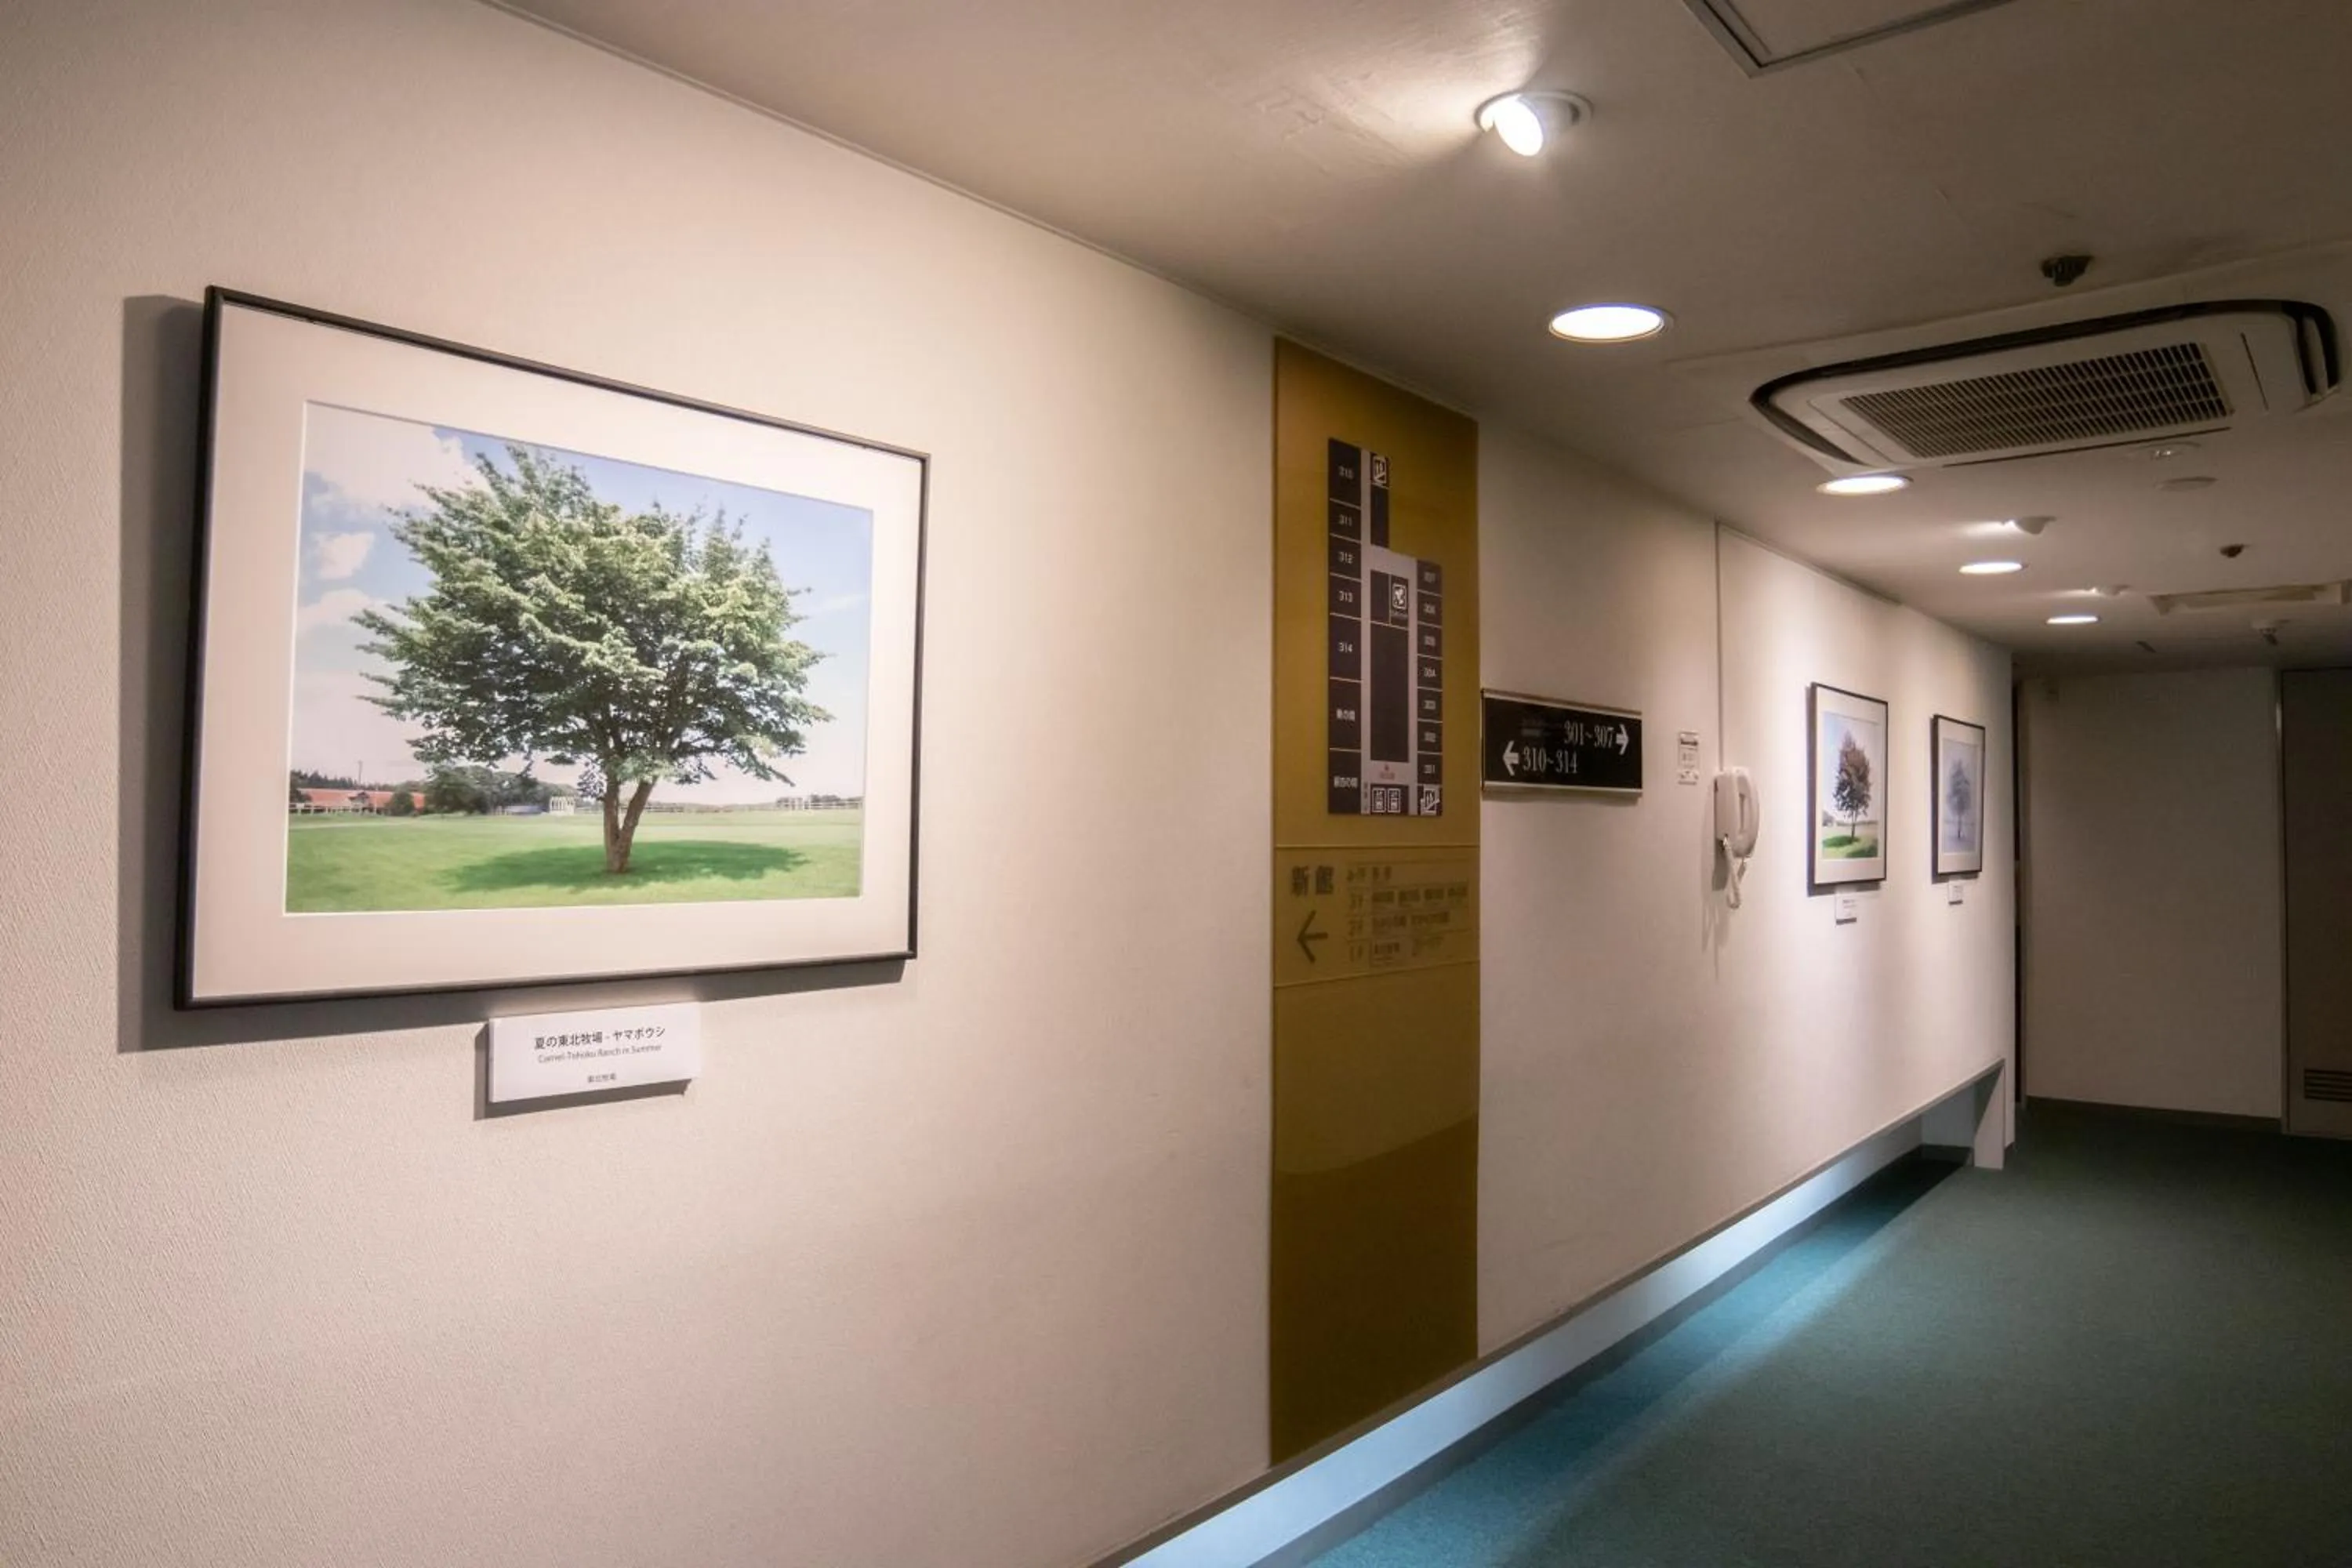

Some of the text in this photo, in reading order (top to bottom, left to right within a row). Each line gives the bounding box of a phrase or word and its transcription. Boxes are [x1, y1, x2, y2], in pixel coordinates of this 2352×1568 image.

[1338, 551, 1353, 564] 312
[1338, 590, 1353, 602] 313
[1338, 642, 1353, 652] 314
[535, 1031, 603, 1050] 夏の東北牧場
